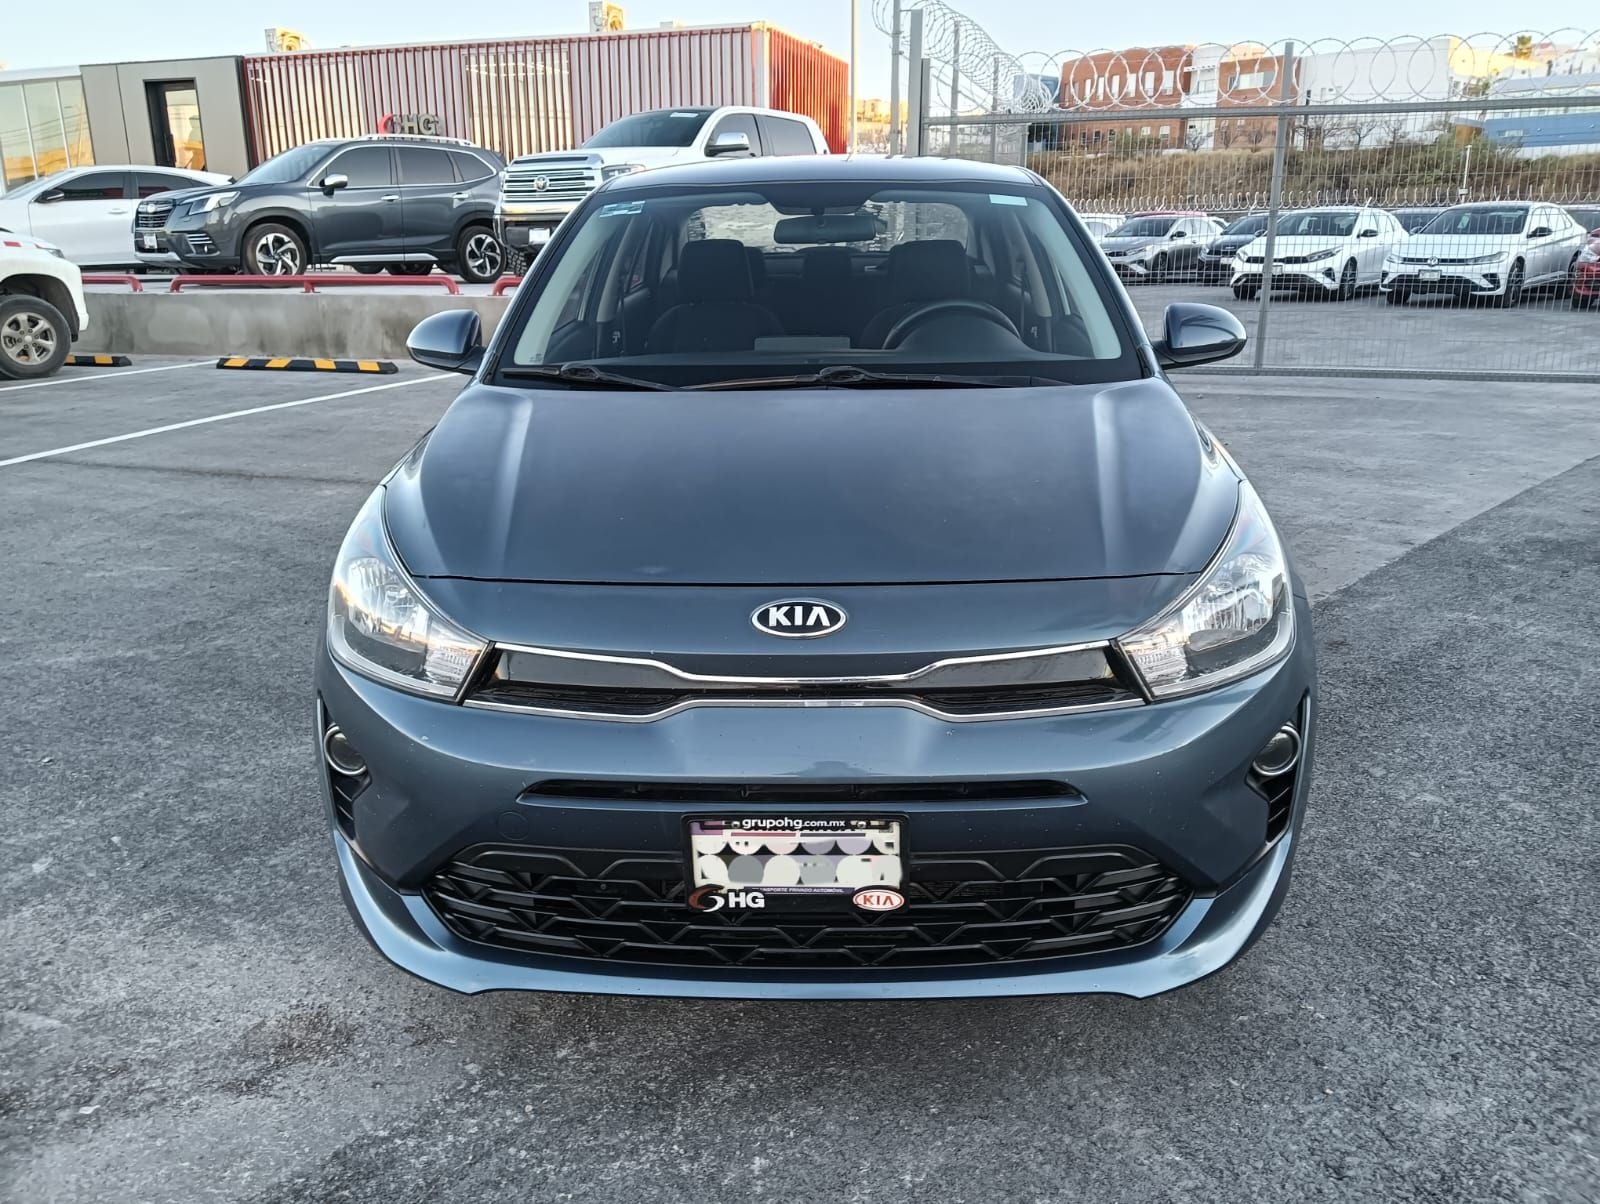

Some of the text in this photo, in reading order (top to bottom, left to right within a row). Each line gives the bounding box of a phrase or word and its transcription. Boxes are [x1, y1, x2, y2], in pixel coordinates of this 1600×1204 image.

[403, 113, 439, 135] HG
[768, 605, 831, 627] KIA
[742, 817, 846, 829] grupohg.com.mx
[728, 891, 765, 908] HG
[863, 895, 894, 906] KIA
